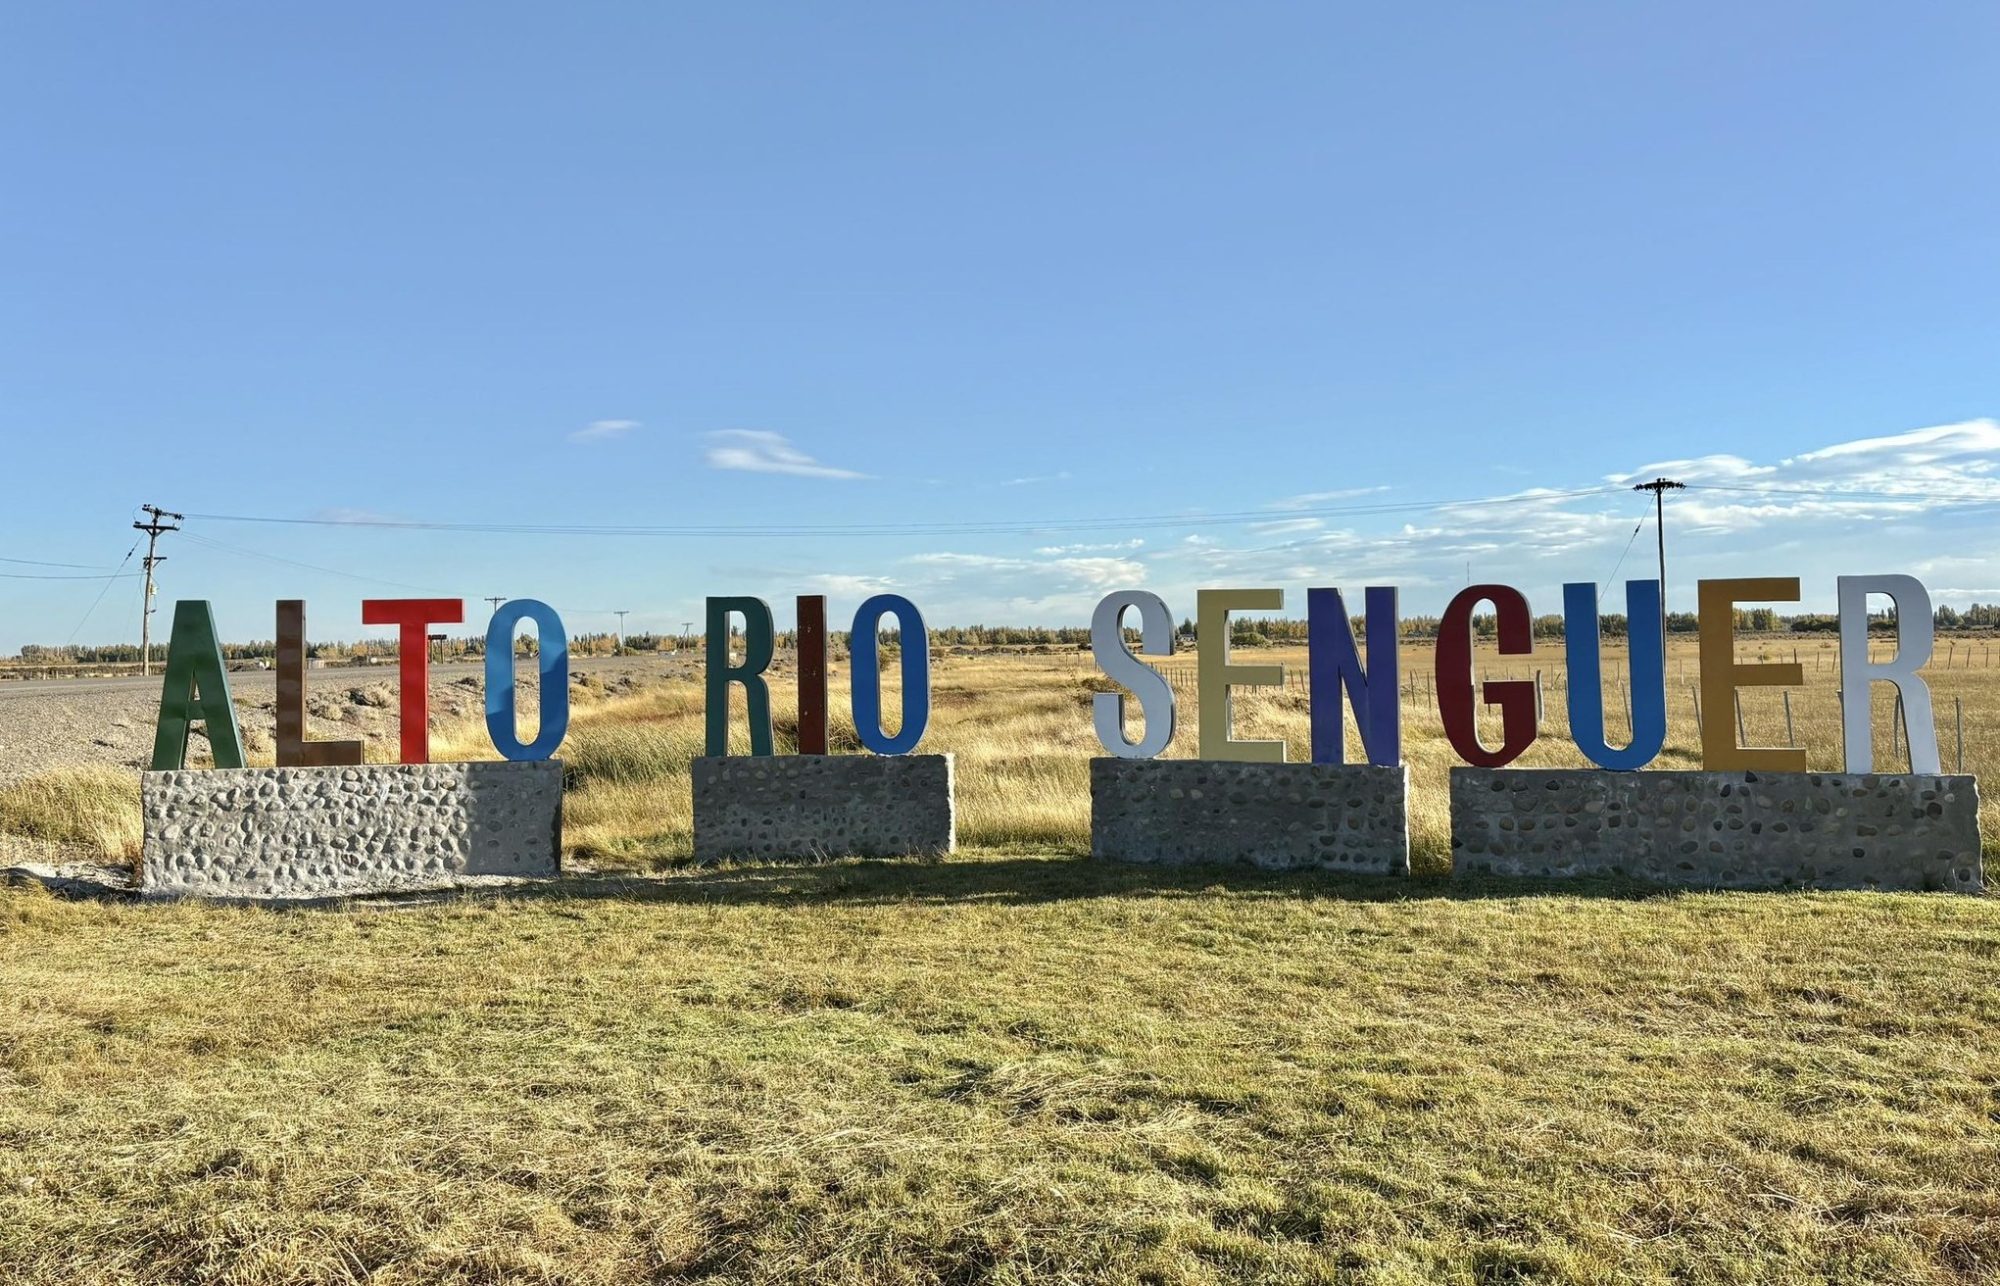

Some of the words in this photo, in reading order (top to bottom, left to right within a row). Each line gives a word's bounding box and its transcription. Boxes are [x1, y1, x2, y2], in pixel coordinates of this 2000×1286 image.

[151, 598, 569, 770] ALTO
[705, 593, 931, 757] RIO
[1091, 574, 1941, 775] SENGUER
